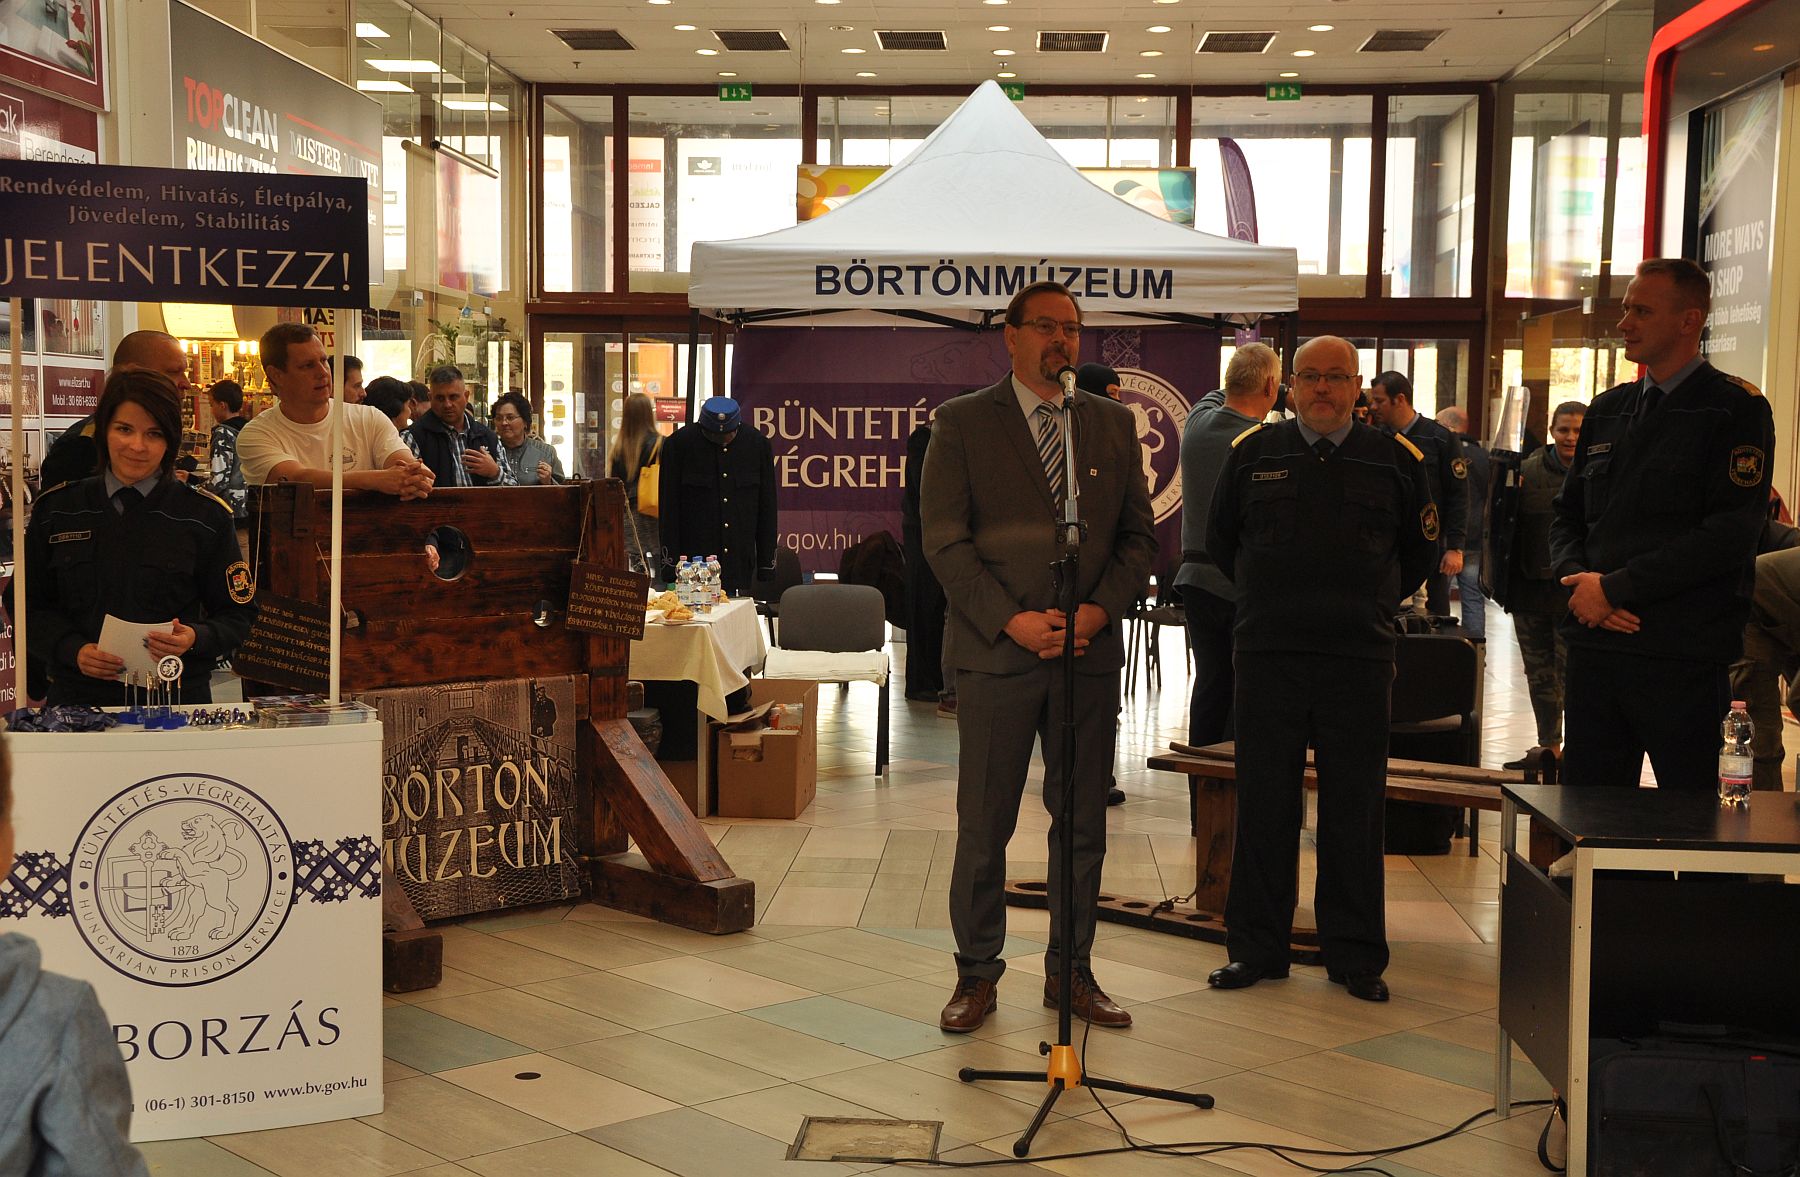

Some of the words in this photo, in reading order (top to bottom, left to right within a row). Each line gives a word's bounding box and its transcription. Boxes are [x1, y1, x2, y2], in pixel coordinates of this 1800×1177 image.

[289, 130, 342, 174] MISTER
[0, 176, 150, 201] Rendvédelem,
[161, 184, 246, 207] Hivatás,
[255, 185, 353, 213] Életpálya,
[68, 205, 185, 229] Jövedelem,
[195, 211, 290, 232] Stabilitás
[1704, 228, 1733, 263] MORE
[1735, 219, 1764, 255] WAYS
[0, 238, 350, 292] JELENTKEZZ!
[815, 258, 1174, 300] BÖRTÖNMÚZEUM
[1716, 264, 1744, 298] SHOP
[382, 754, 550, 827] BÖRTÖN
[79, 780, 287, 870] BÜNTETÉS-VÉGREHAJTÁS
[79, 899, 158, 976] HUNGARIAN
[170, 953, 237, 979] PRISON
[244, 888, 287, 954] SERVICE
[172, 945, 200, 957] 1878
[145, 1096, 186, 1113] (06-1)
[190, 1090, 256, 1109] 301-8150
[263, 1076, 368, 1100] www.bv.gov.hu
